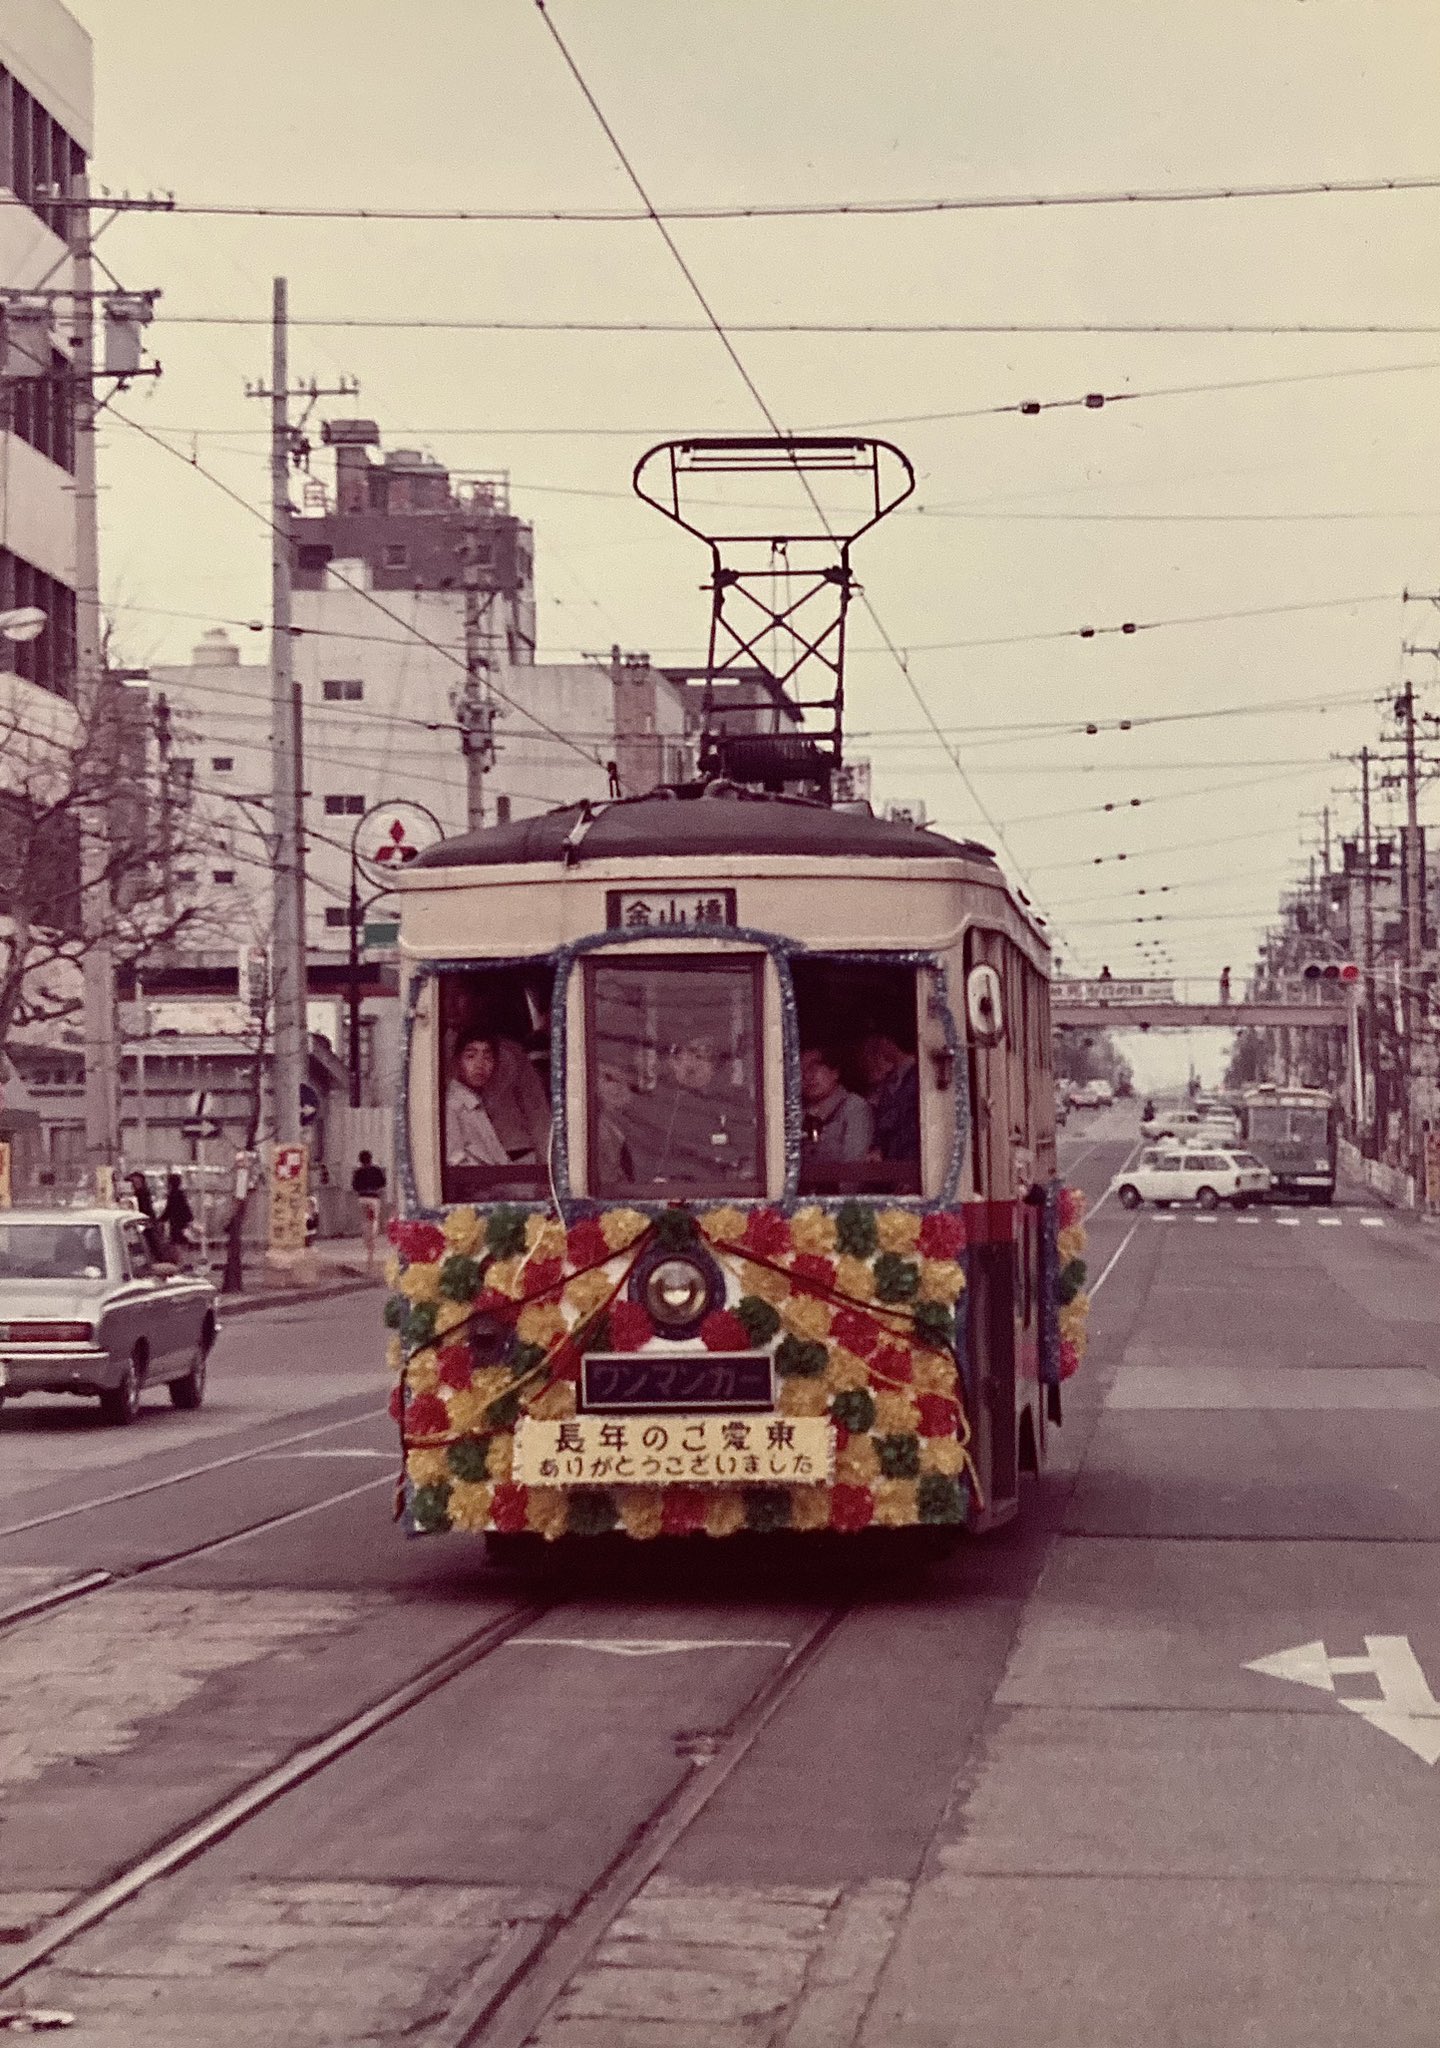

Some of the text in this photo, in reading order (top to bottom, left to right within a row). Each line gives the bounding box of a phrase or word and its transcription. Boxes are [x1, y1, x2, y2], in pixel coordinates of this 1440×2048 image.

[626, 899, 724, 927] 金山橋
[593, 1365, 762, 1397] ワンマンカー
